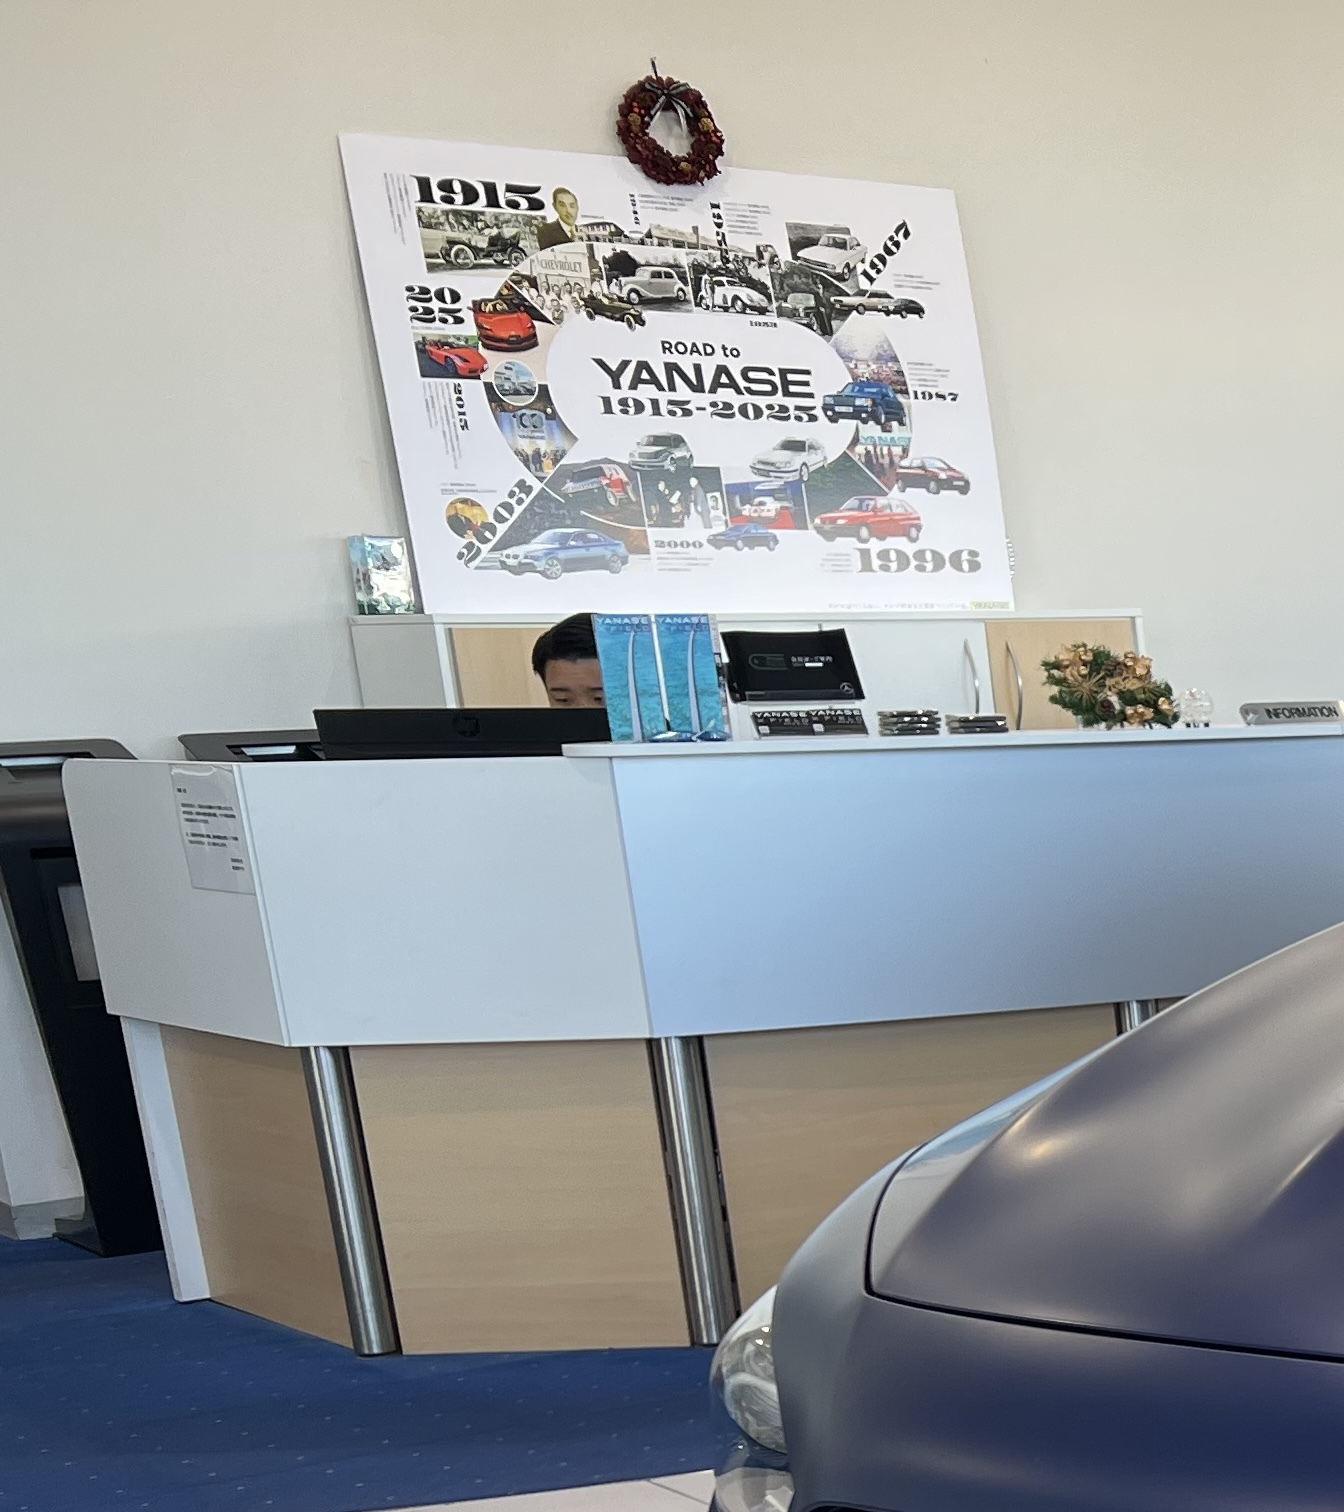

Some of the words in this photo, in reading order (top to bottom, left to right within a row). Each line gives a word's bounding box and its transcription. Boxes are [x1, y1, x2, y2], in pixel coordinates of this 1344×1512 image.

[410, 175, 546, 211] 1915
[860, 219, 911, 285] 1967
[540, 259, 583, 273] CHEVROLET
[405, 285, 462, 304] 20
[408, 305, 465, 325] 25
[661, 340, 715, 356] ROAD
[721, 344, 741, 358] to
[591, 357, 815, 399] YANASE
[453, 382, 470, 432] 2015
[598, 395, 819, 423] 1915-2025
[456, 478, 534, 568] 2003
[654, 539, 704, 549] 2000
[853, 547, 982, 574] 1996
[596, 616, 649, 625] YANASE
[656, 616, 708, 624] YANASE
[809, 708, 861, 716] YANASE
[1264, 706, 1339, 719] INFORMATION
